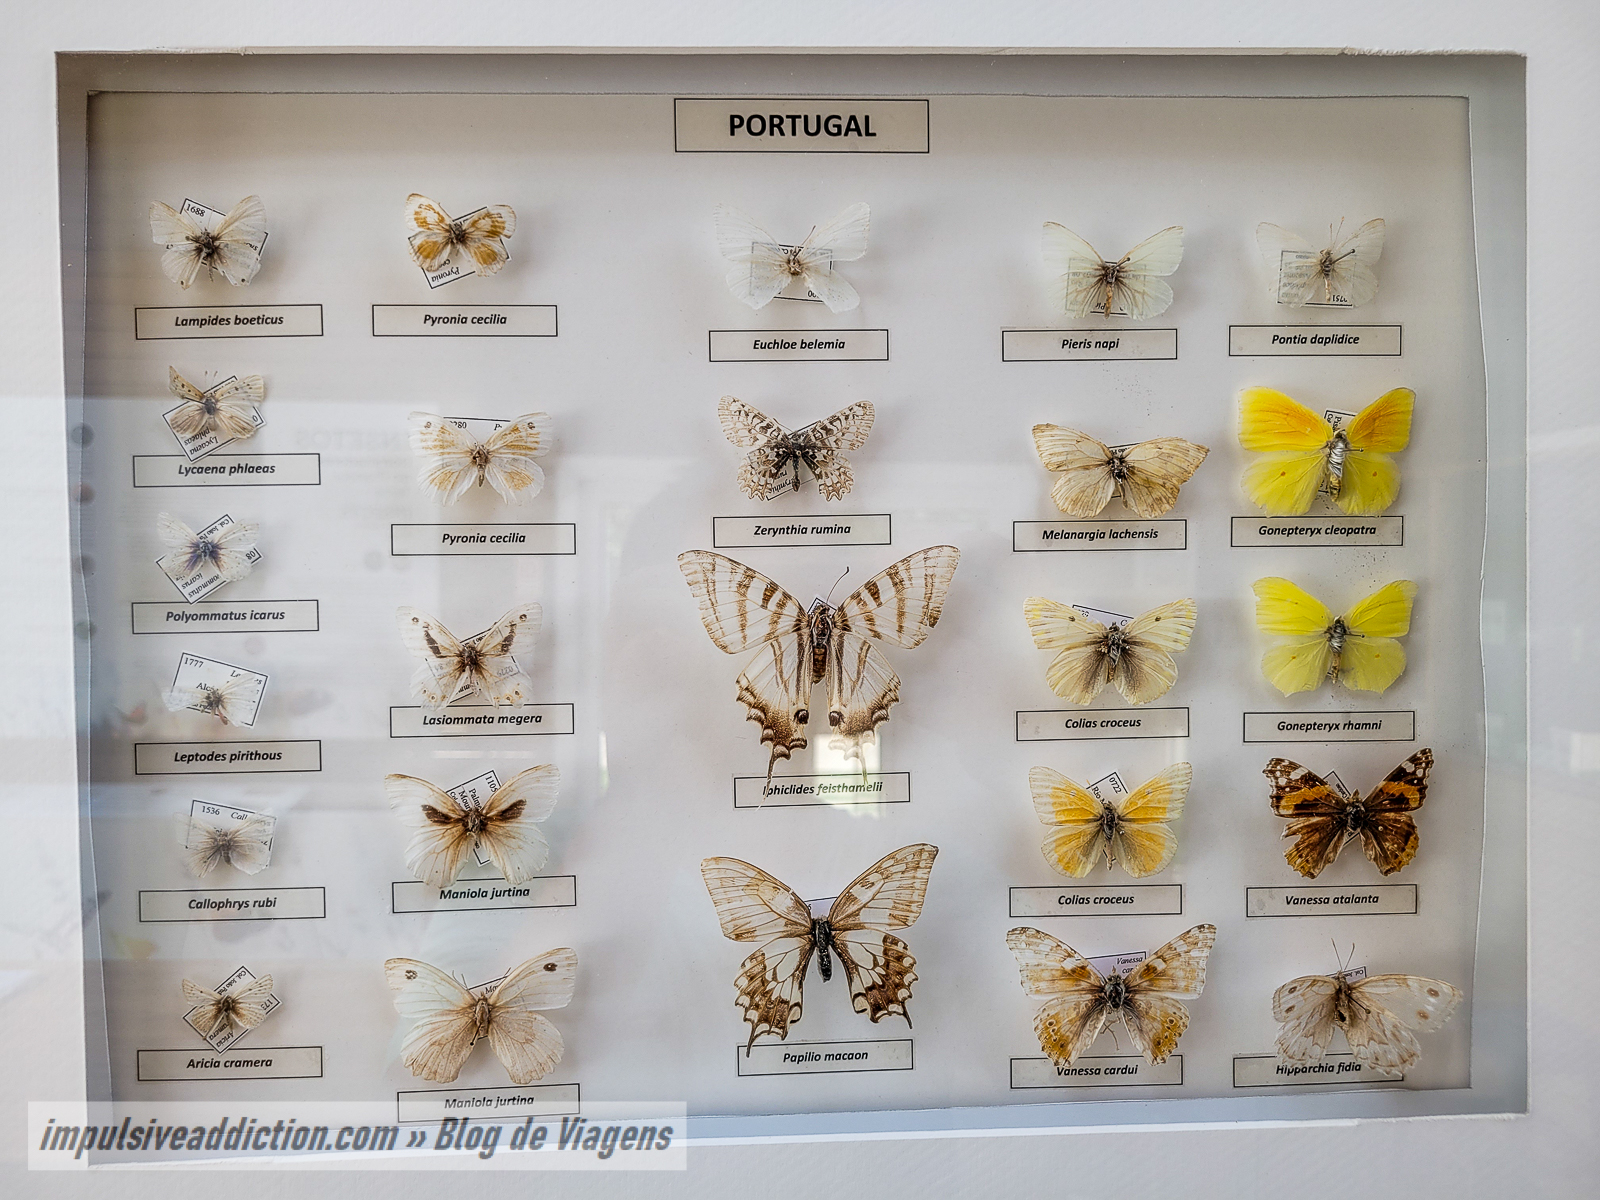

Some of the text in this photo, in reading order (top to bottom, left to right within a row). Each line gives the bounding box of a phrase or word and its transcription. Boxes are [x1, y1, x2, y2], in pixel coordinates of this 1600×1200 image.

[729, 113, 877, 138] PORTUGAL
[186, 203, 206, 217] 1688
[429, 265, 461, 285] Pyronia
[174, 314, 284, 329] Lampides boeticus
[423, 313, 508, 327] Pyronia cecilia
[752, 338, 846, 350] Euchloe belemia
[1061, 337, 1120, 351] Pieris napi
[1271, 333, 1360, 347] Pontia daplidice
[182, 426, 212, 448] phlaeas
[188, 434, 220, 458] Lycaena
[178, 463, 276, 476] Lycaena phlaeas
[753, 523, 852, 538] Zerynthia rumina
[1041, 528, 1159, 542] Melanargia lachensis
[1258, 524, 1377, 538] Gonepteryx cleopatra
[441, 532, 527, 546] Pyronia cecilia
[180, 571, 204, 592] icarus
[165, 609, 286, 624] Polyommatus icarus
[184, 657, 204, 668] 1777
[422, 714, 543, 726] Lasiommata megera
[1064, 717, 1142, 729] Colias croceus
[1277, 719, 1383, 733] Gonepteryx rhamni
[173, 749, 283, 765] Leptodes pirithous
[762, 782, 883, 797] Iphiclides feisthamelii
[1108, 777, 1122, 794] 0722
[201, 805, 221, 816] 1536
[438, 886, 531, 900] Maniola jurtina
[1057, 894, 1135, 906] Colias croceus
[1285, 893, 1380, 906] Vanessa atalanta
[188, 896, 278, 912] Callophrys rubi
[1117, 956, 1143, 965] Vanessa
[207, 1021, 231, 1042] ramera
[215, 1030, 236, 1050] Aricia
[185, 1057, 273, 1069] Aricia cramera
[782, 1051, 869, 1065] Papilio macaon
[1056, 1064, 1139, 1076] Vanessa cardui
[1275, 1062, 1363, 1076] Hipparchia fidia
[444, 1095, 535, 1109] Maniola jurtina
